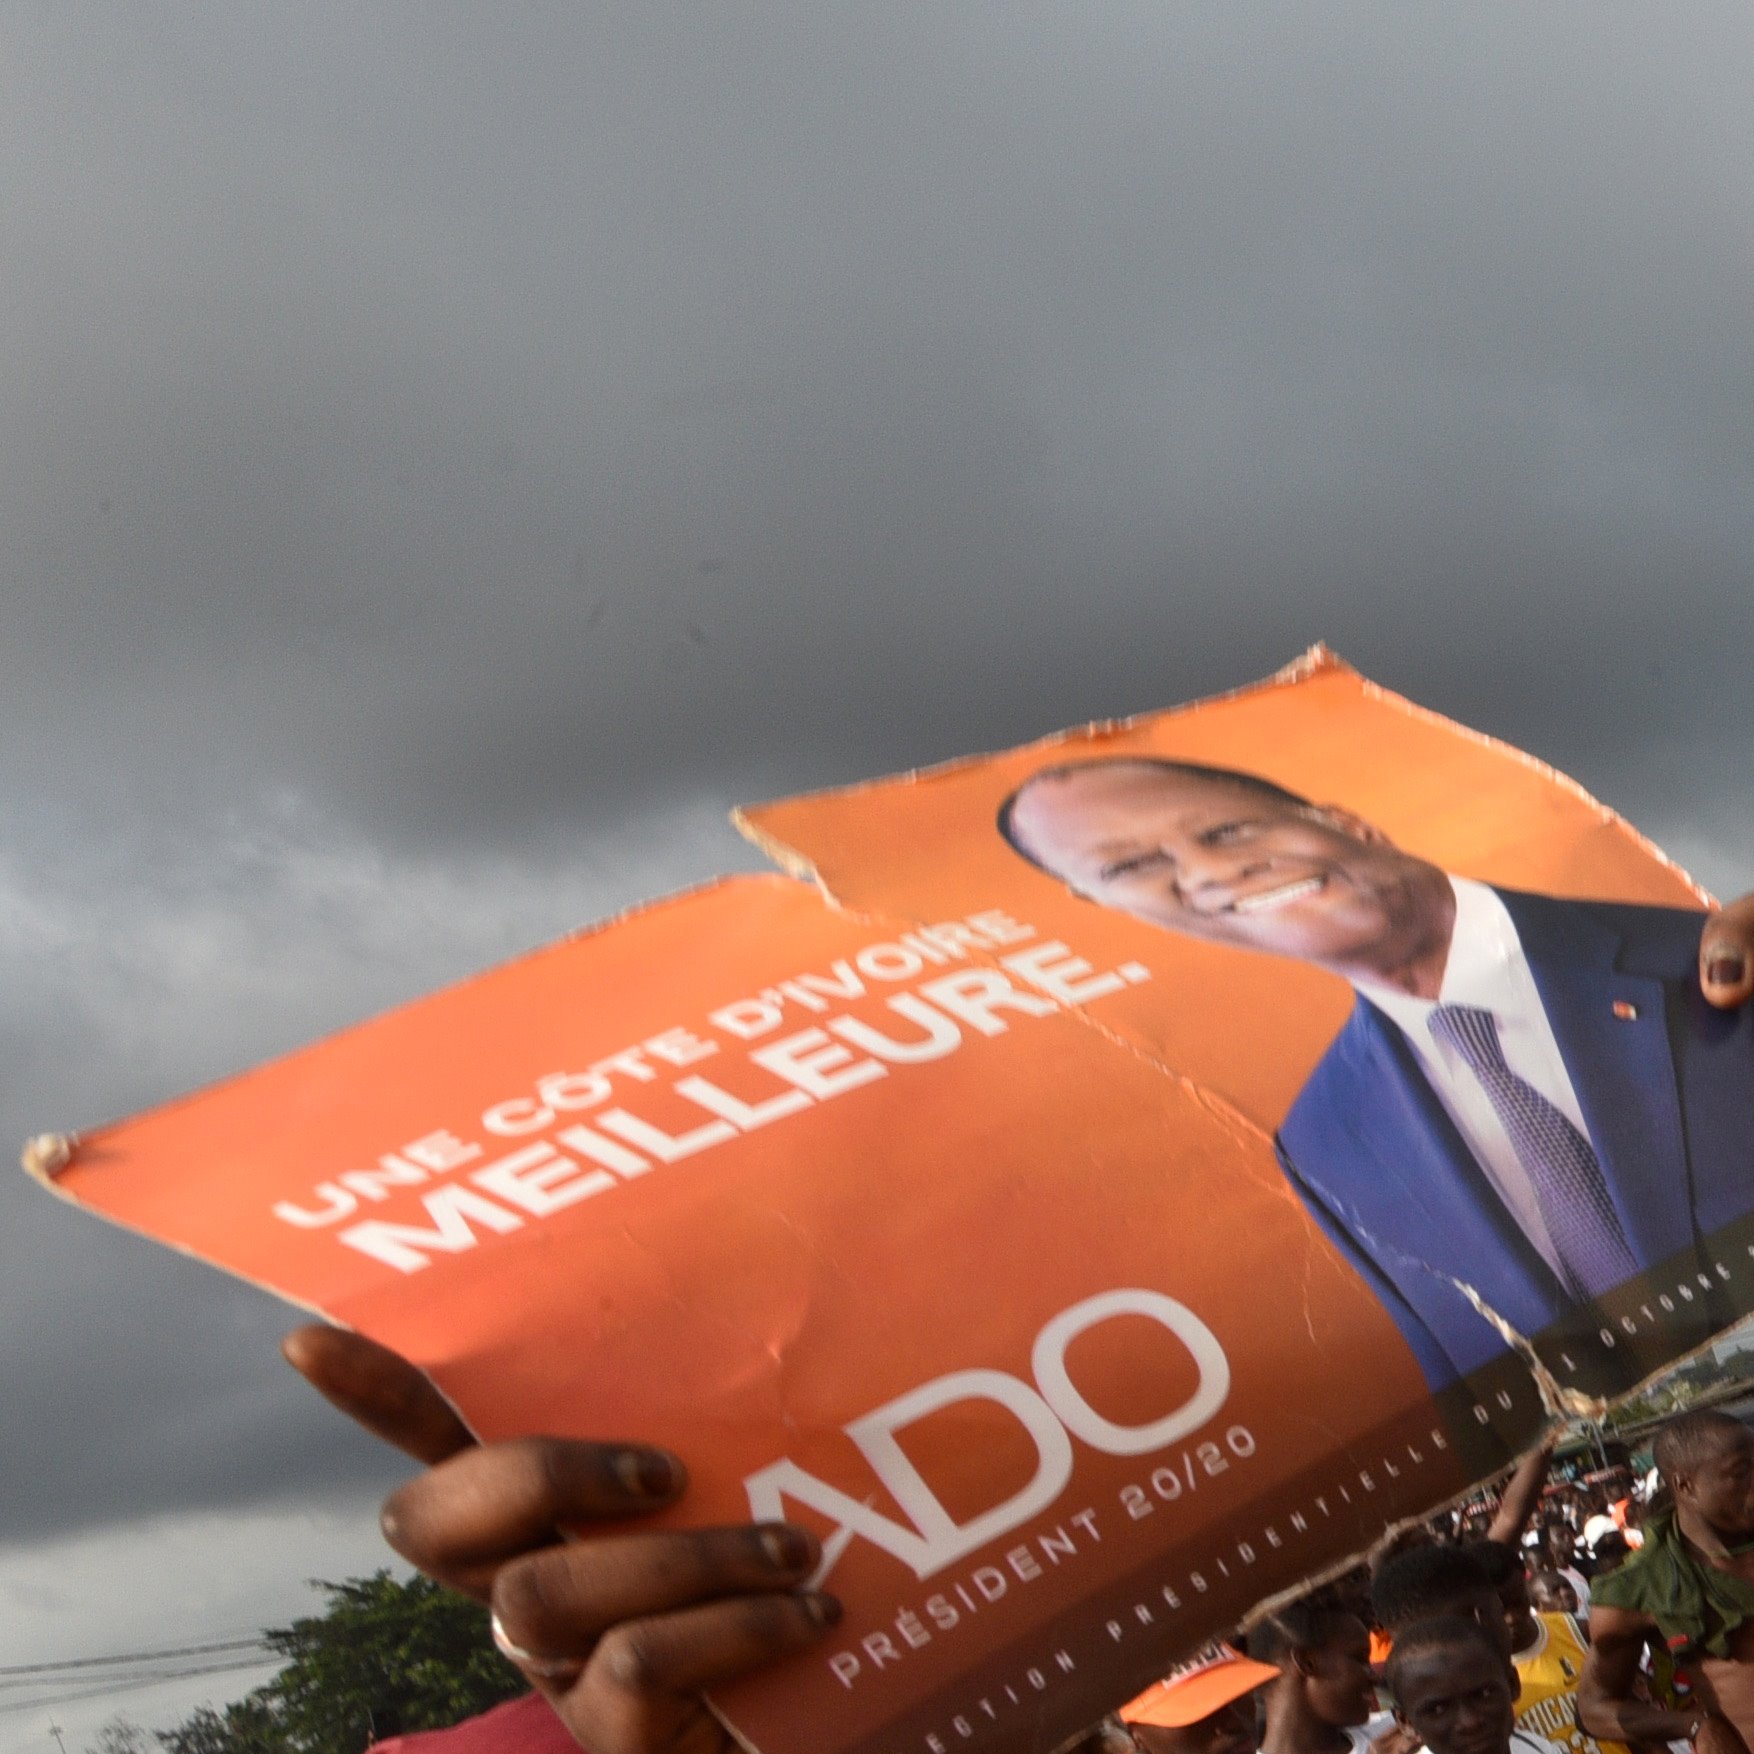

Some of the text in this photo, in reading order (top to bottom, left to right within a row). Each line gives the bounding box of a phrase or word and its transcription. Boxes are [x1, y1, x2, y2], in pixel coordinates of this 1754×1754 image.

[276, 908, 1036, 1229] UNE CÔTE D'IVOIRE
[339, 940, 1152, 1275] MEILLEURE.
[743, 1287, 1231, 1581] ADO
[829, 1424, 1257, 1689] PRÉSIDENT 20/20
[1106, 1428, 1448, 1642] PRÉSIDENTIELLE
[1474, 1390, 1514, 1426] DU
[1600, 1262, 1733, 1348] OCTOBRE
